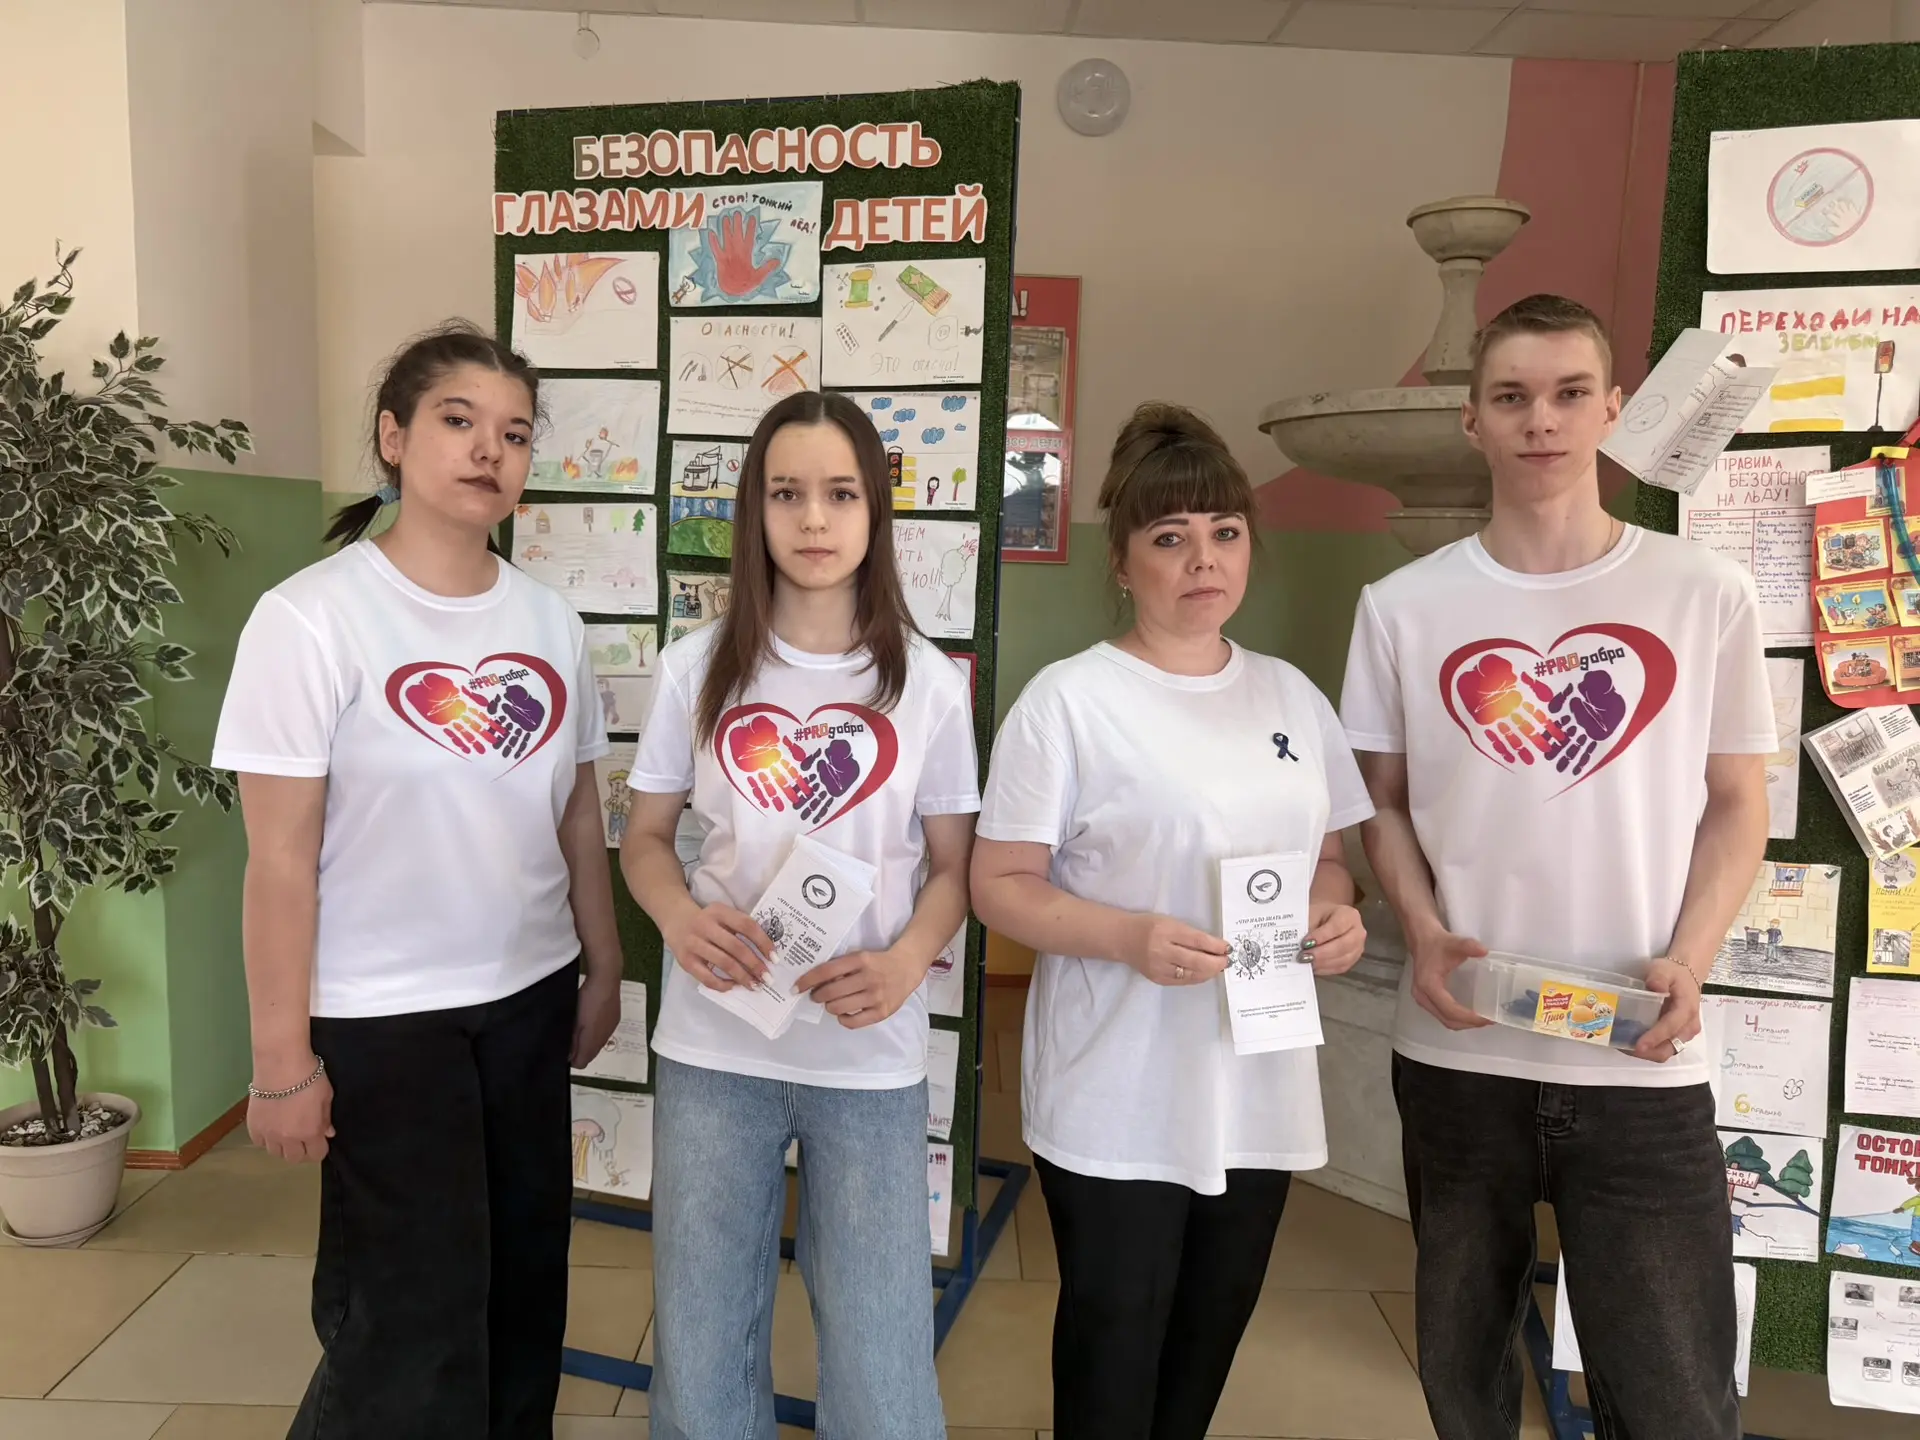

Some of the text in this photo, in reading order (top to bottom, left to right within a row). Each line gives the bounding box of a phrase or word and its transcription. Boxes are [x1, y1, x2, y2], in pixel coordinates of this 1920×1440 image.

[573, 122, 941, 179] БЕЗОПАСНОСТЬ
[712, 192, 793, 211] СТОП! ТОНКИЙ
[494, 185, 986, 250] ГЛАЗАМИ ДЕТЕЙ
[1720, 305, 1920, 334] ПЕРЕХОДИ НА
[1717, 493, 1735, 507] НА
